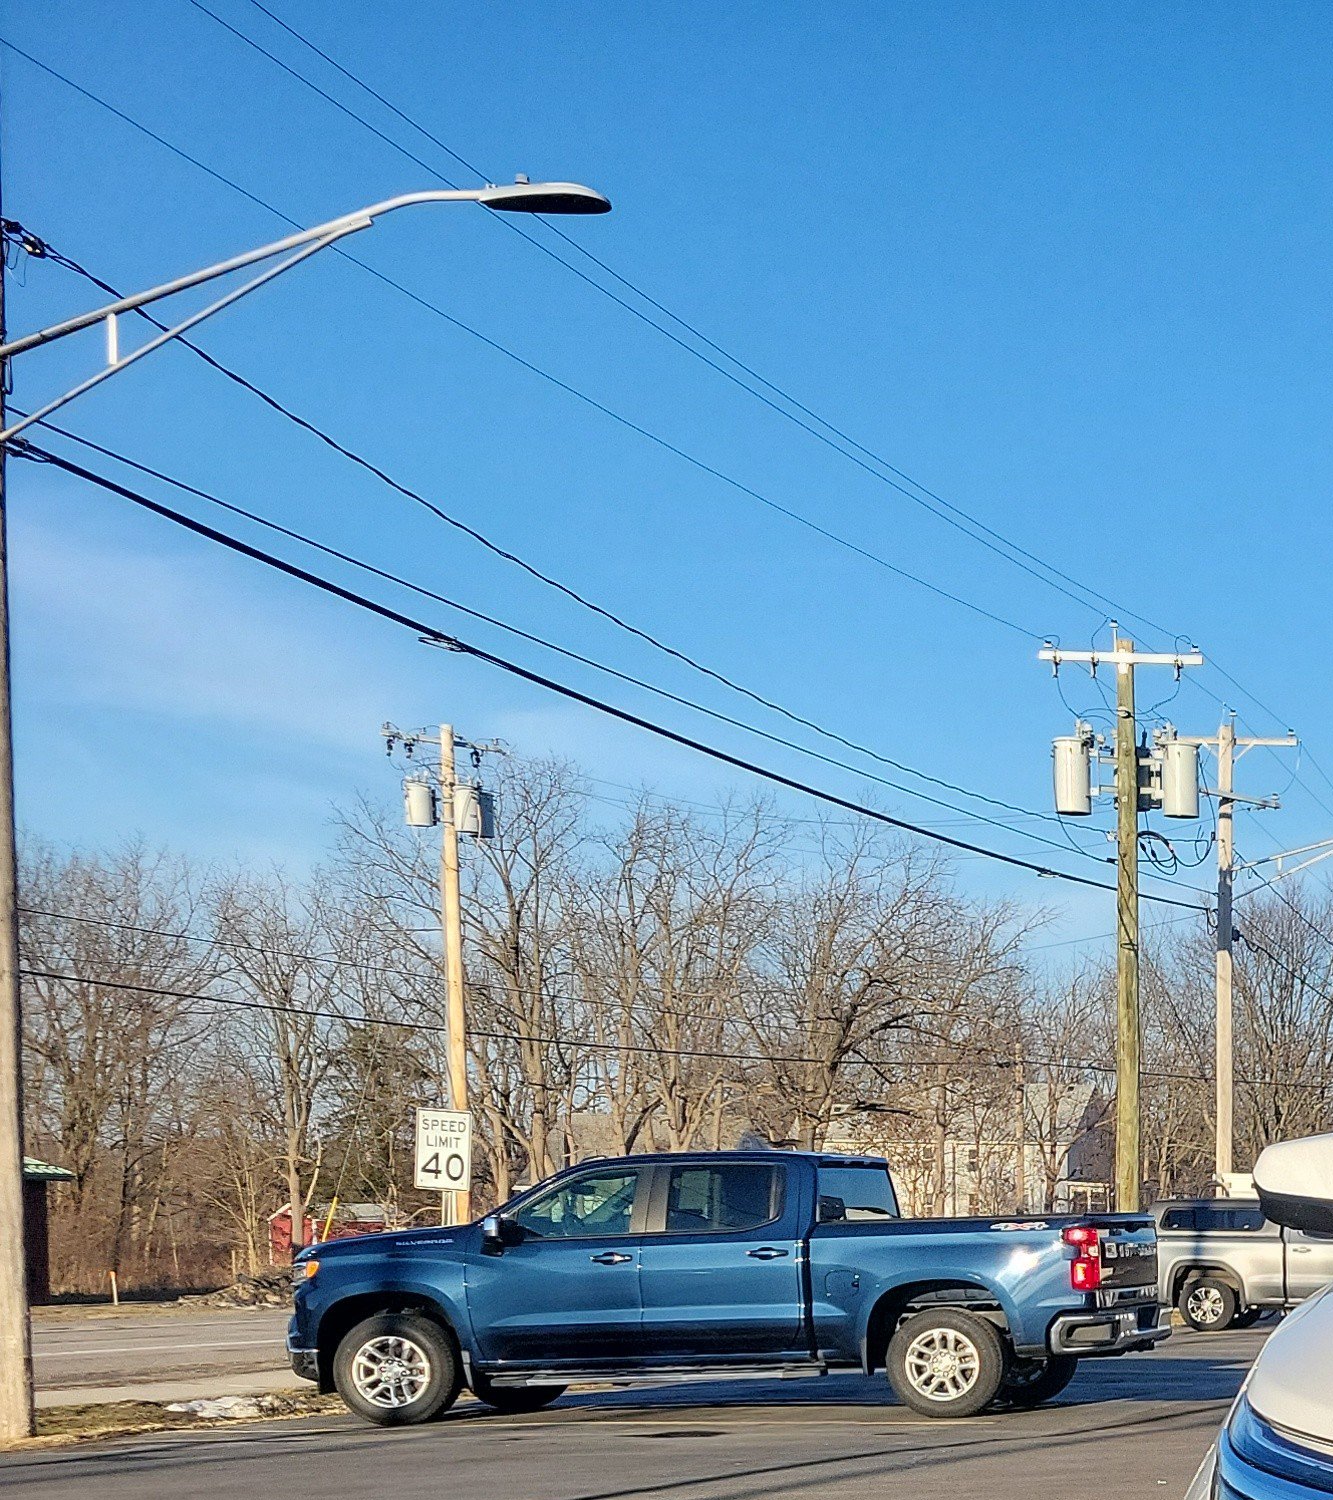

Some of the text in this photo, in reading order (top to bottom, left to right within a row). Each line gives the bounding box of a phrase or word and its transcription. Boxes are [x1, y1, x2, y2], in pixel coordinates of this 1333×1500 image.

[422, 1118, 466, 1133] SPEED
[426, 1135, 461, 1148] LIMIT
[421, 1152, 465, 1181] 40
